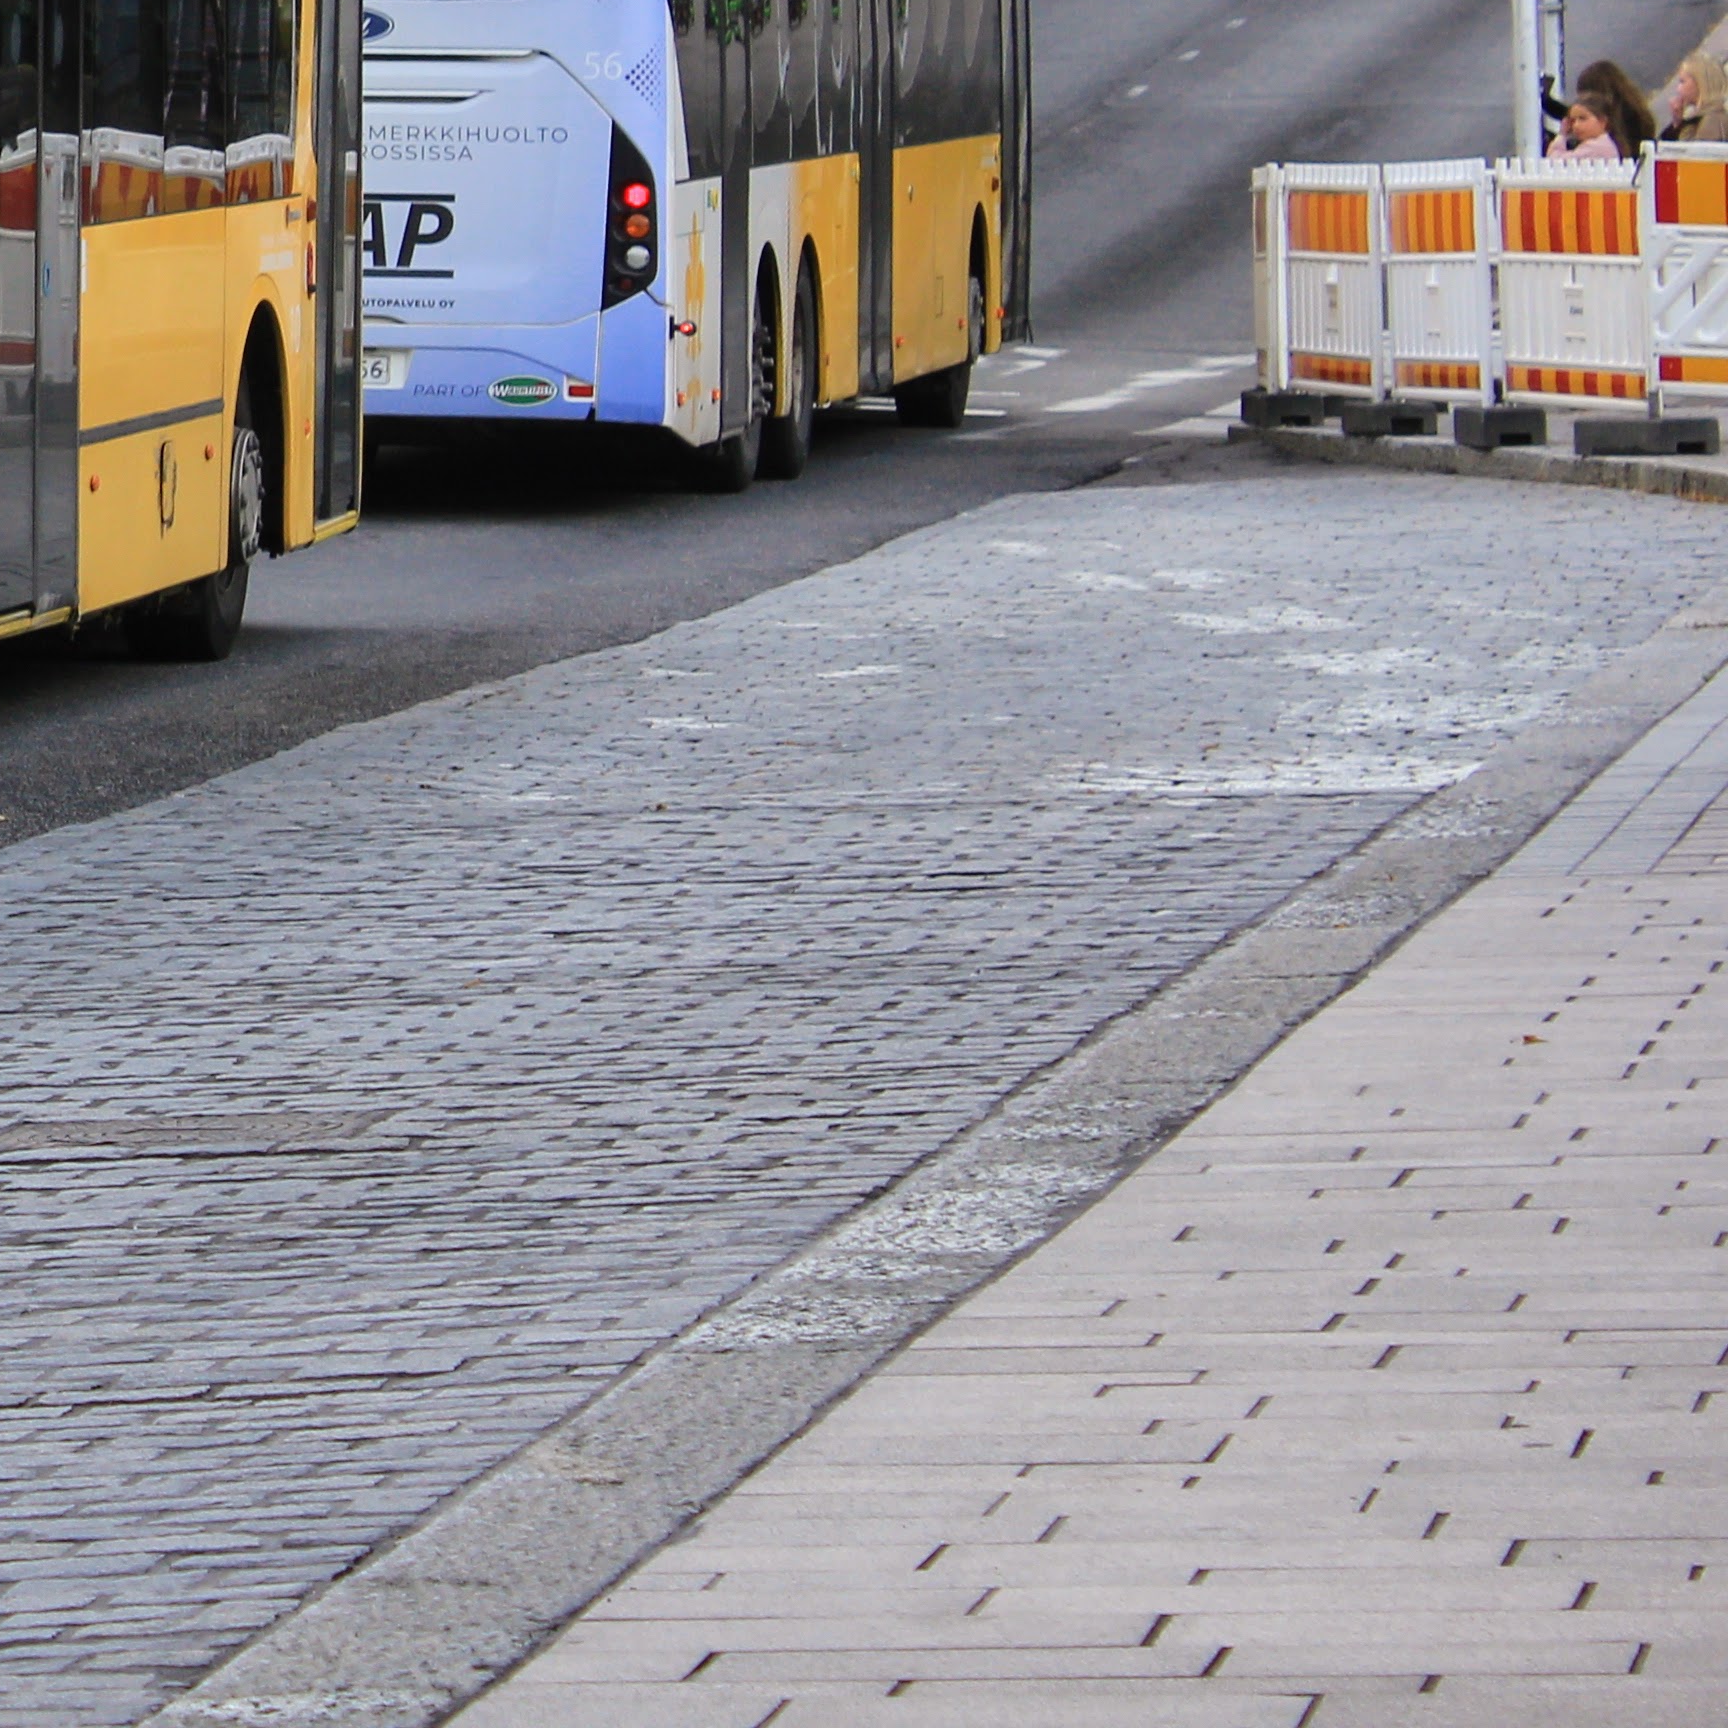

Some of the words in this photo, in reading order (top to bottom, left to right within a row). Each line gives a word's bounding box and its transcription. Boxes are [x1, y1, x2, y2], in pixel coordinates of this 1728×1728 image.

[583, 51, 623, 80] 56
[369, 125, 569, 144] MERKKIHUOLTO
[439, 299, 456, 309] OY
[412, 384, 457, 397] PART
[461, 384, 486, 398] OF
